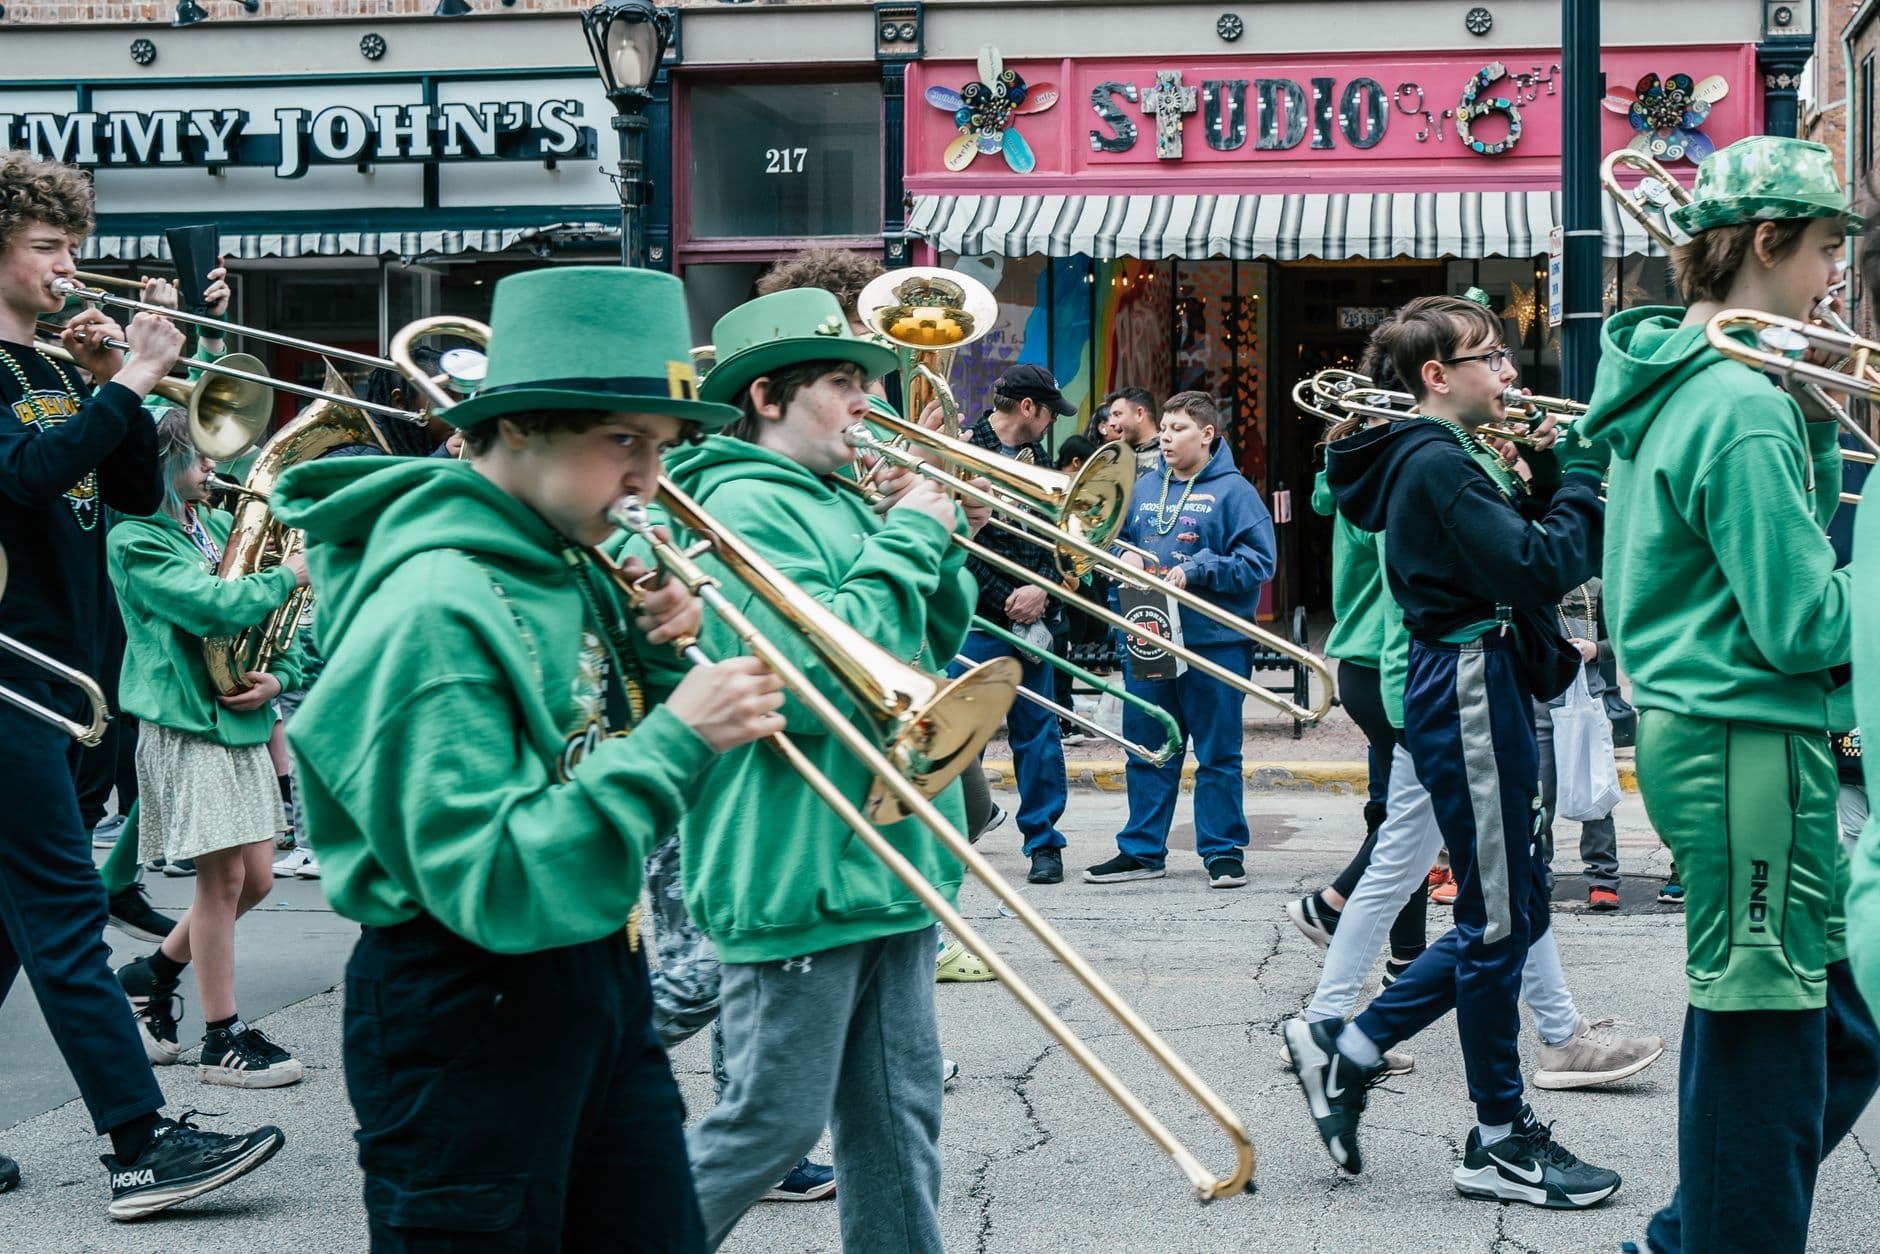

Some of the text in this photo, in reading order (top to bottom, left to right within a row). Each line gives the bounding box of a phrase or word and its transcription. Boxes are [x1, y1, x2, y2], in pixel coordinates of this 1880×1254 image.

[275, 99, 584, 178] JOHN'S
[765, 147, 808, 174] 217
[1748, 859, 1769, 934] AND1
[112, 1169, 156, 1190] HOKA
